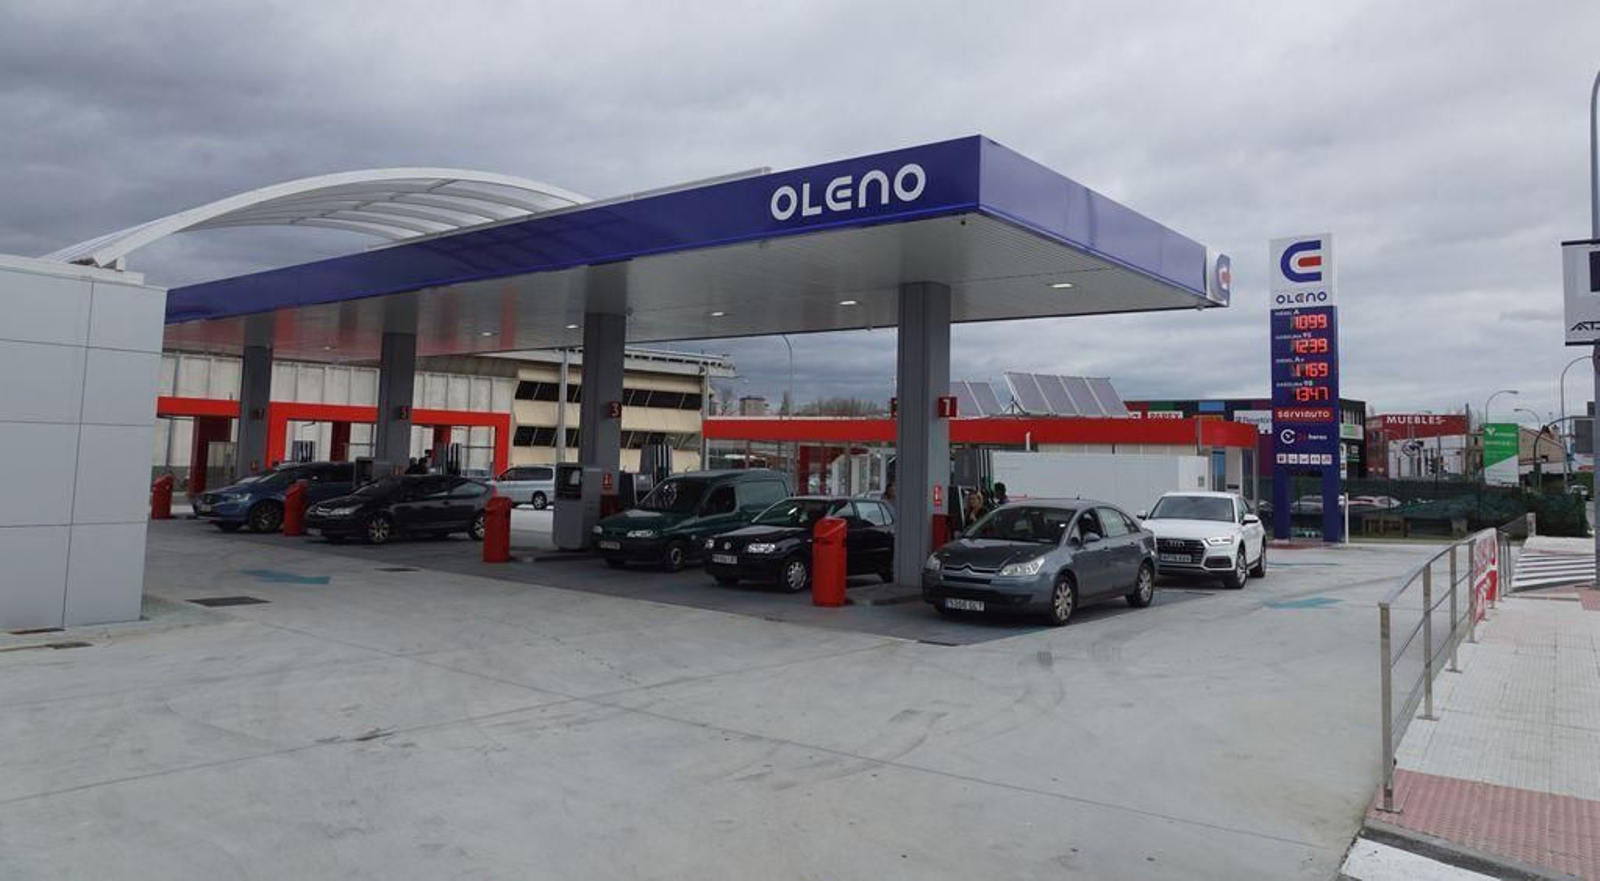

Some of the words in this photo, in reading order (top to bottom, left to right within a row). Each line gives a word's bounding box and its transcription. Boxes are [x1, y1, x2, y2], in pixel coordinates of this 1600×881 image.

[770, 163, 926, 221] OLENO
[1276, 291, 1327, 304] OLENO
[1296, 386, 1328, 402] 1347
[1386, 415, 1442, 425] MUEBLES
